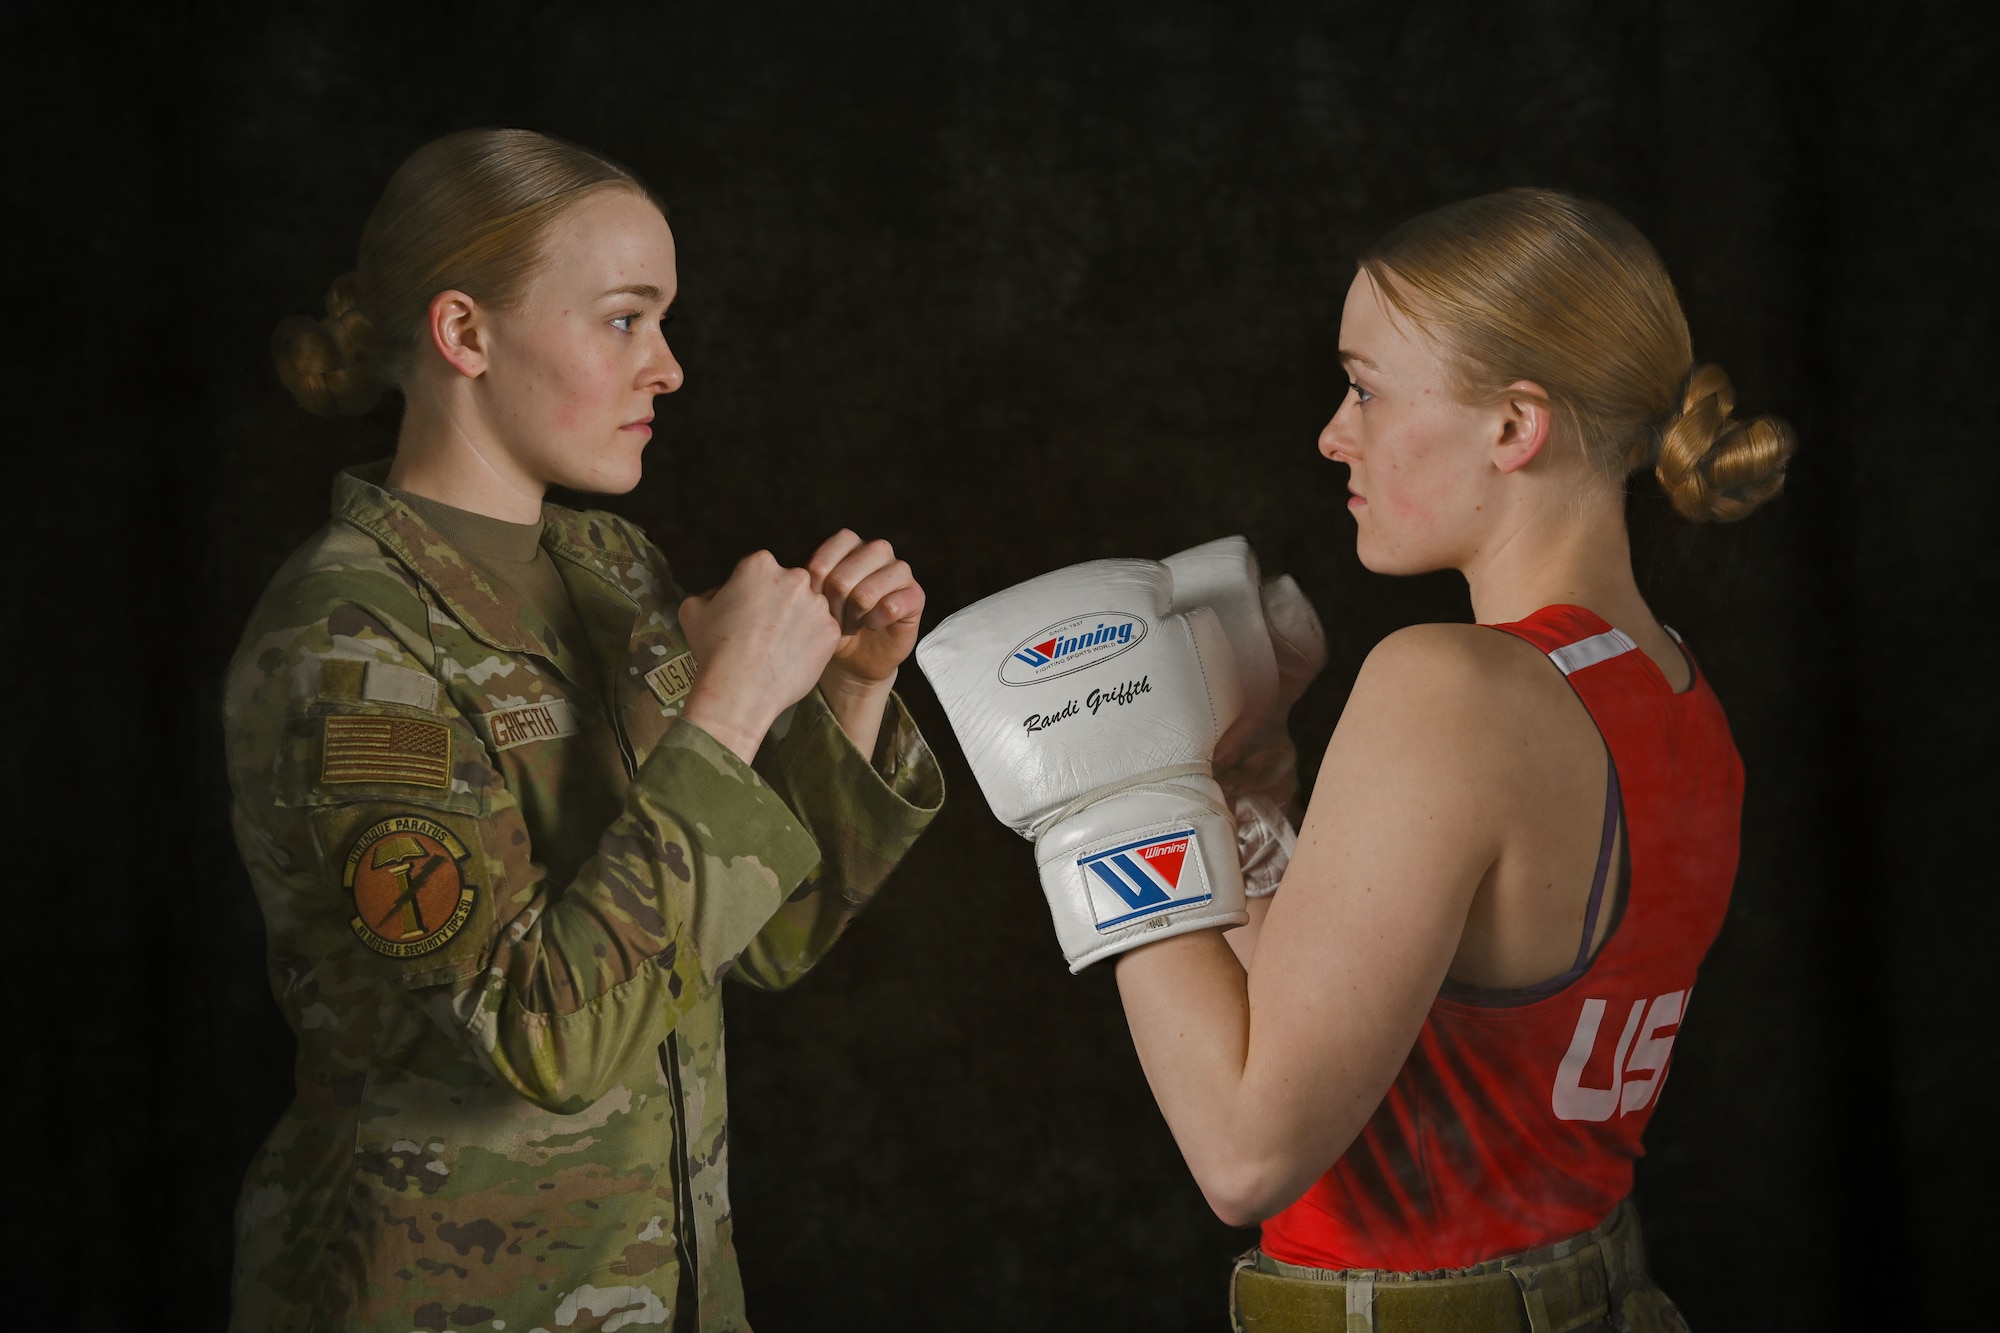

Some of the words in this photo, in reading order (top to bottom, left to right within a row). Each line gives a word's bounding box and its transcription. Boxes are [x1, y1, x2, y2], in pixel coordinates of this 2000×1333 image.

[1013, 622, 1133, 668] Winning
[1049, 626, 1068, 637] SINCE
[1069, 620, 1084, 629] 1937
[1035, 658, 1066, 675] FIGHTING
[1066, 649, 1092, 662] SPORTS
[1093, 642, 1116, 652] WORLD
[490, 706, 560, 746] GRIFFITH
[1023, 700, 1080, 738] Randi
[1086, 675, 1152, 716] Griffth
[350, 822, 392, 864] UTRINQUE
[395, 818, 449, 841] PARATUS
[1144, 842, 1187, 860] Winning
[366, 933, 402, 956] MISSILE
[403, 928, 449, 956] SECURITY
[446, 913, 465, 933] OPS
[1551, 988, 1695, 1122] US
